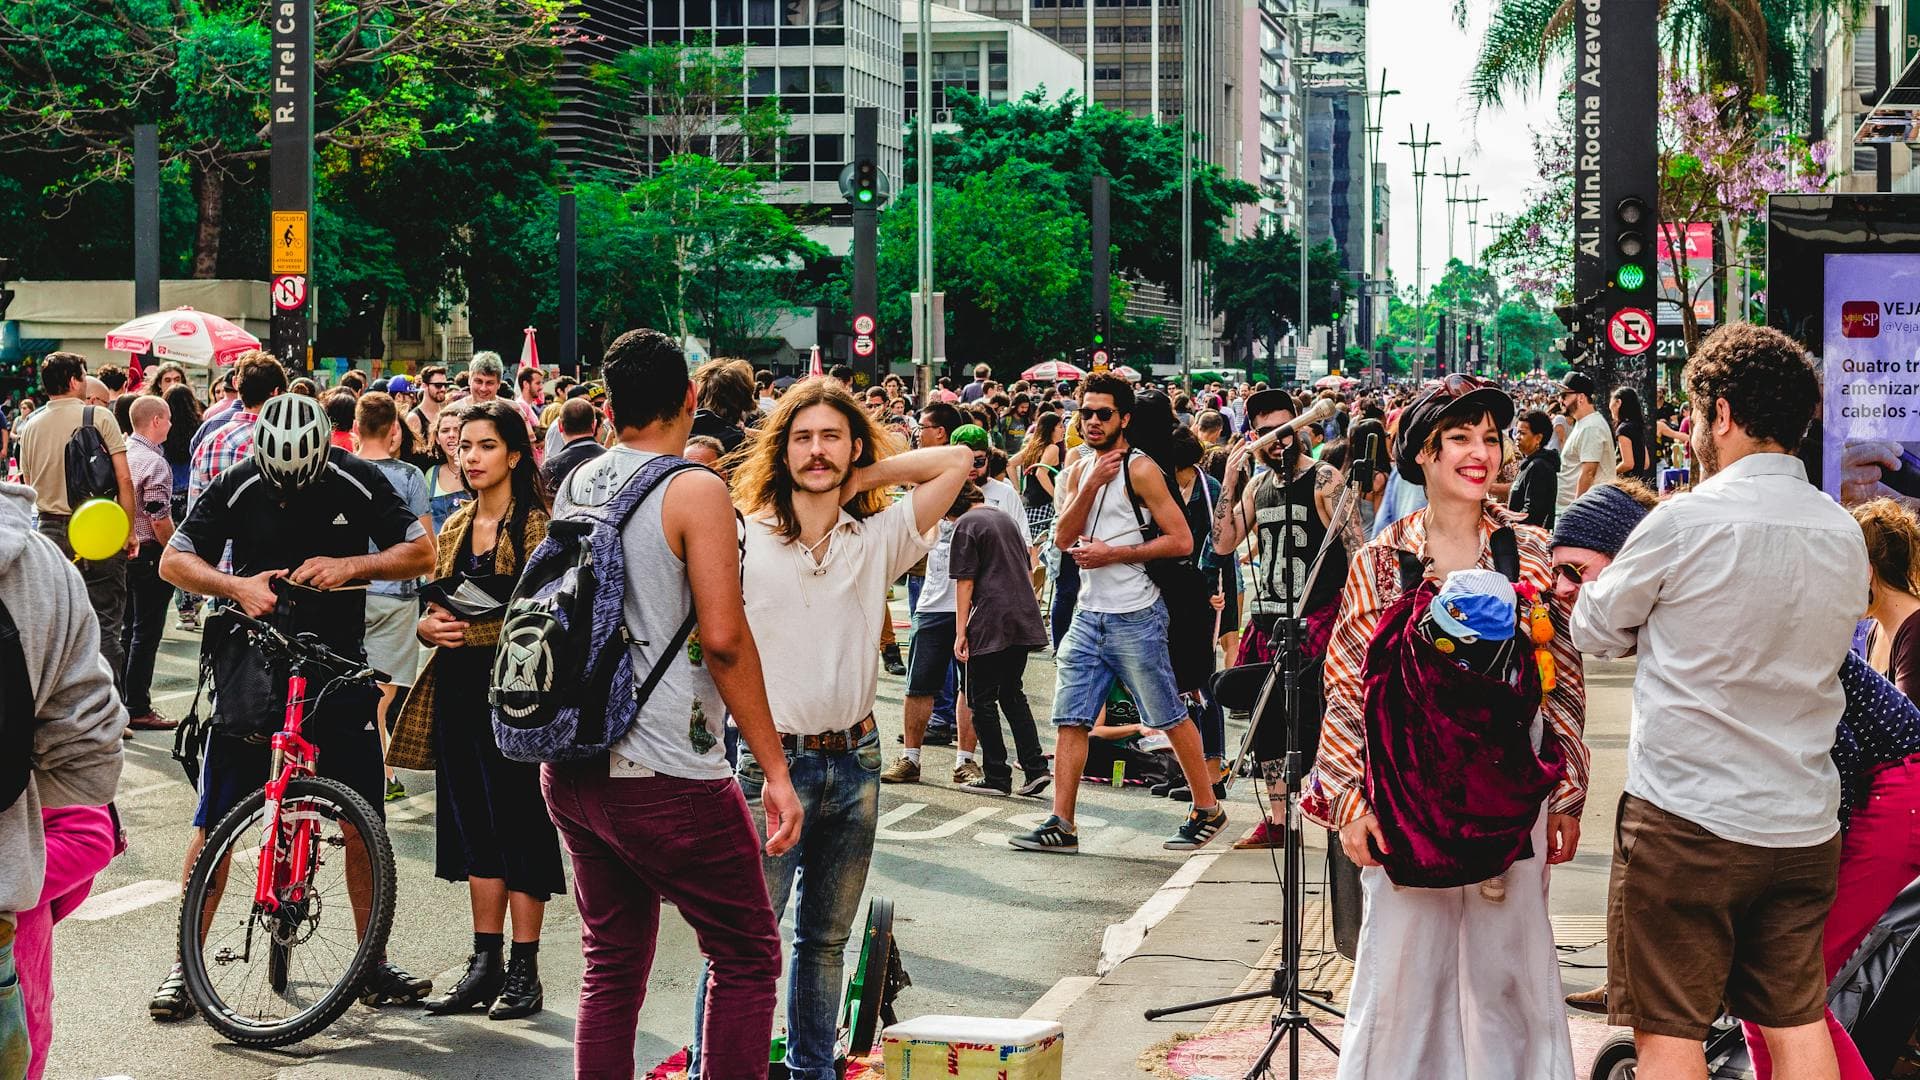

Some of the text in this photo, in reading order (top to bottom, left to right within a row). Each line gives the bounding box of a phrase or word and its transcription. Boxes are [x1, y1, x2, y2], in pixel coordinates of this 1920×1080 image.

[275, 0, 296, 123] R. Frei Ca
[1580, 226, 1601, 258] Al.
[1842, 359, 1901, 373] Quatro
[1841, 381, 1920, 395] amenizar
[1841, 403, 1907, 418] cabelos
